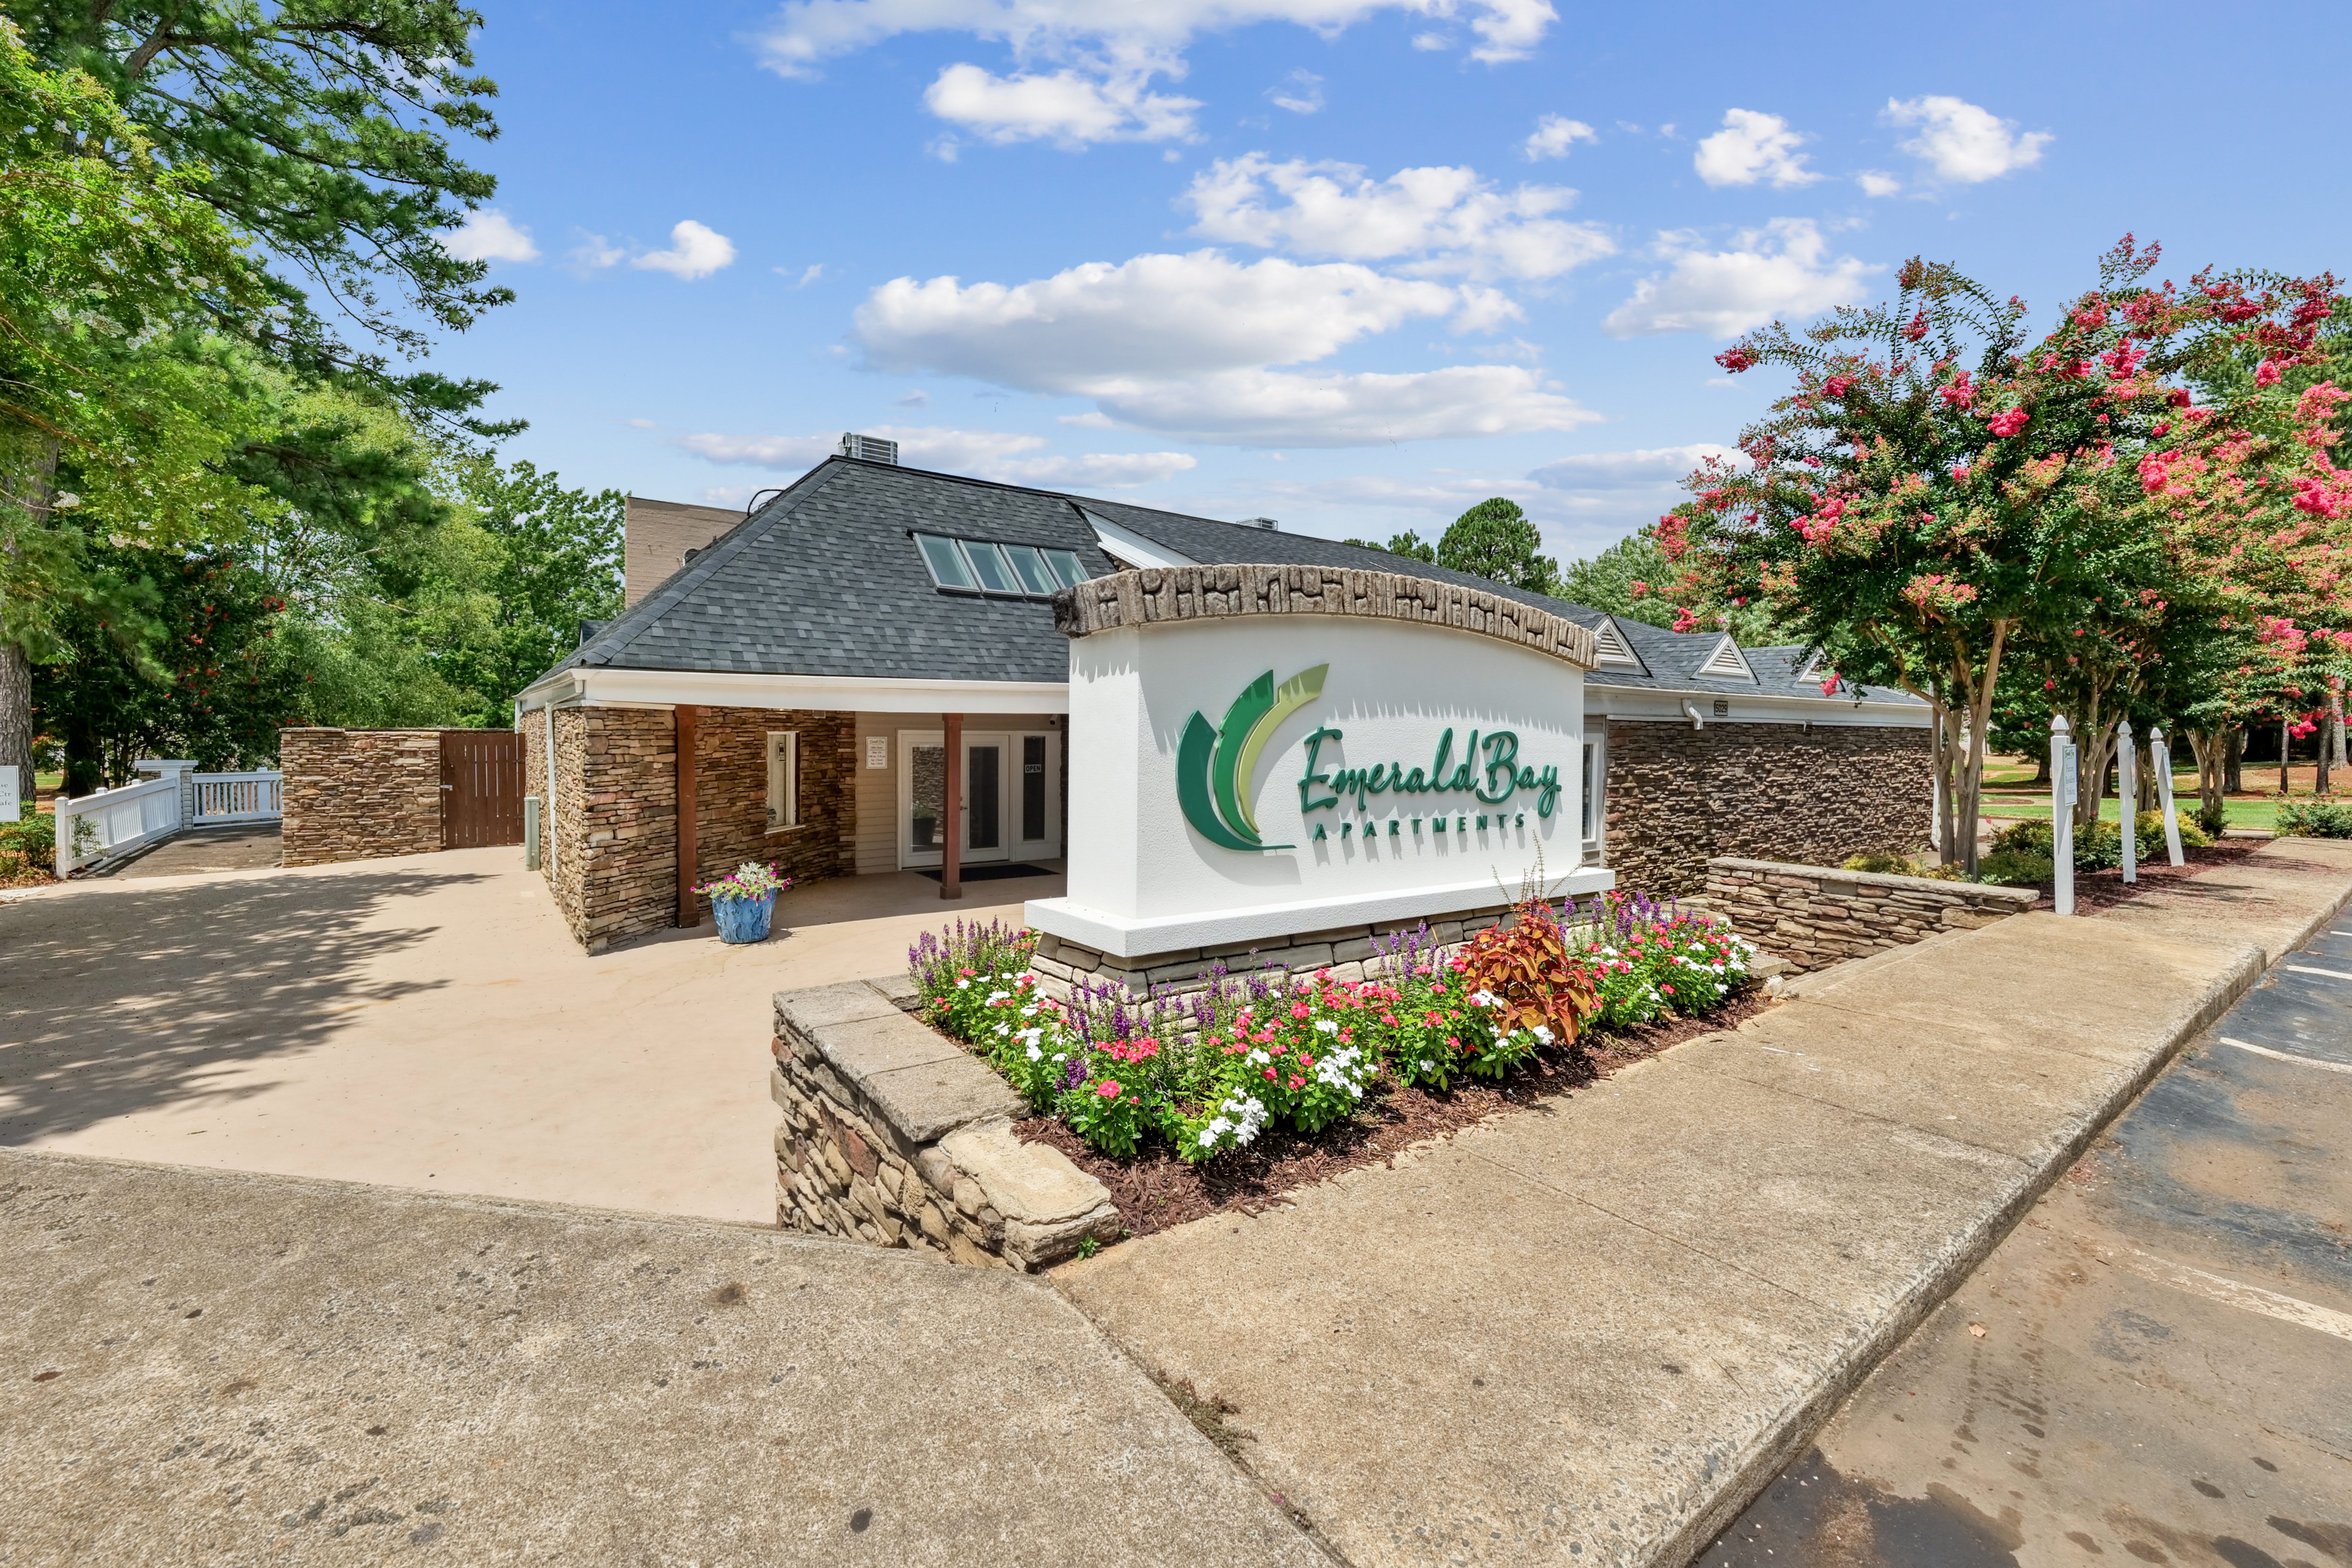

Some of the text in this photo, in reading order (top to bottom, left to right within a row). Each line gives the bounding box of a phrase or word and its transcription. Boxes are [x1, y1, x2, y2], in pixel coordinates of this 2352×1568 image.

[1715, 704, 1727, 713] 5029
[1298, 726, 1562, 818] Emerald Bay
[1312, 813, 1524, 841] APARTMENTS
